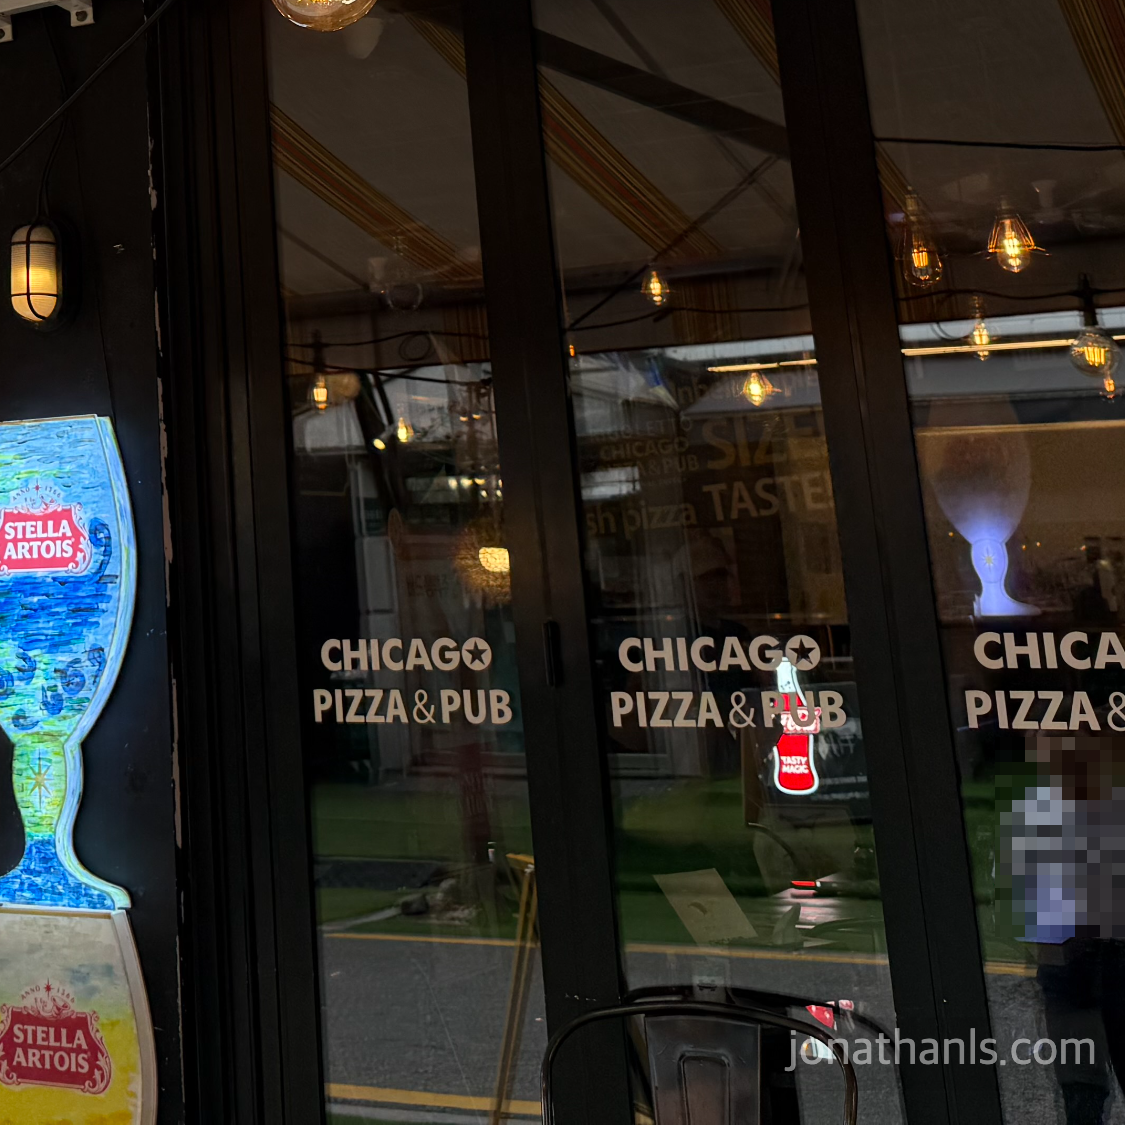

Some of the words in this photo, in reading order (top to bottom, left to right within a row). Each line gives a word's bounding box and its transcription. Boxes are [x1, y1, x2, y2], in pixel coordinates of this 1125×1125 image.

[4, 519, 73, 540] STELLA
[3, 539, 74, 560] ARTOIS
[320, 637, 493, 671] CHICAGO
[618, 634, 821, 672] CHICAGO
[780, 755, 808, 765] TASTY
[13, 1023, 89, 1050] STELLA
[12, 1047, 90, 1073] ARTOIS
